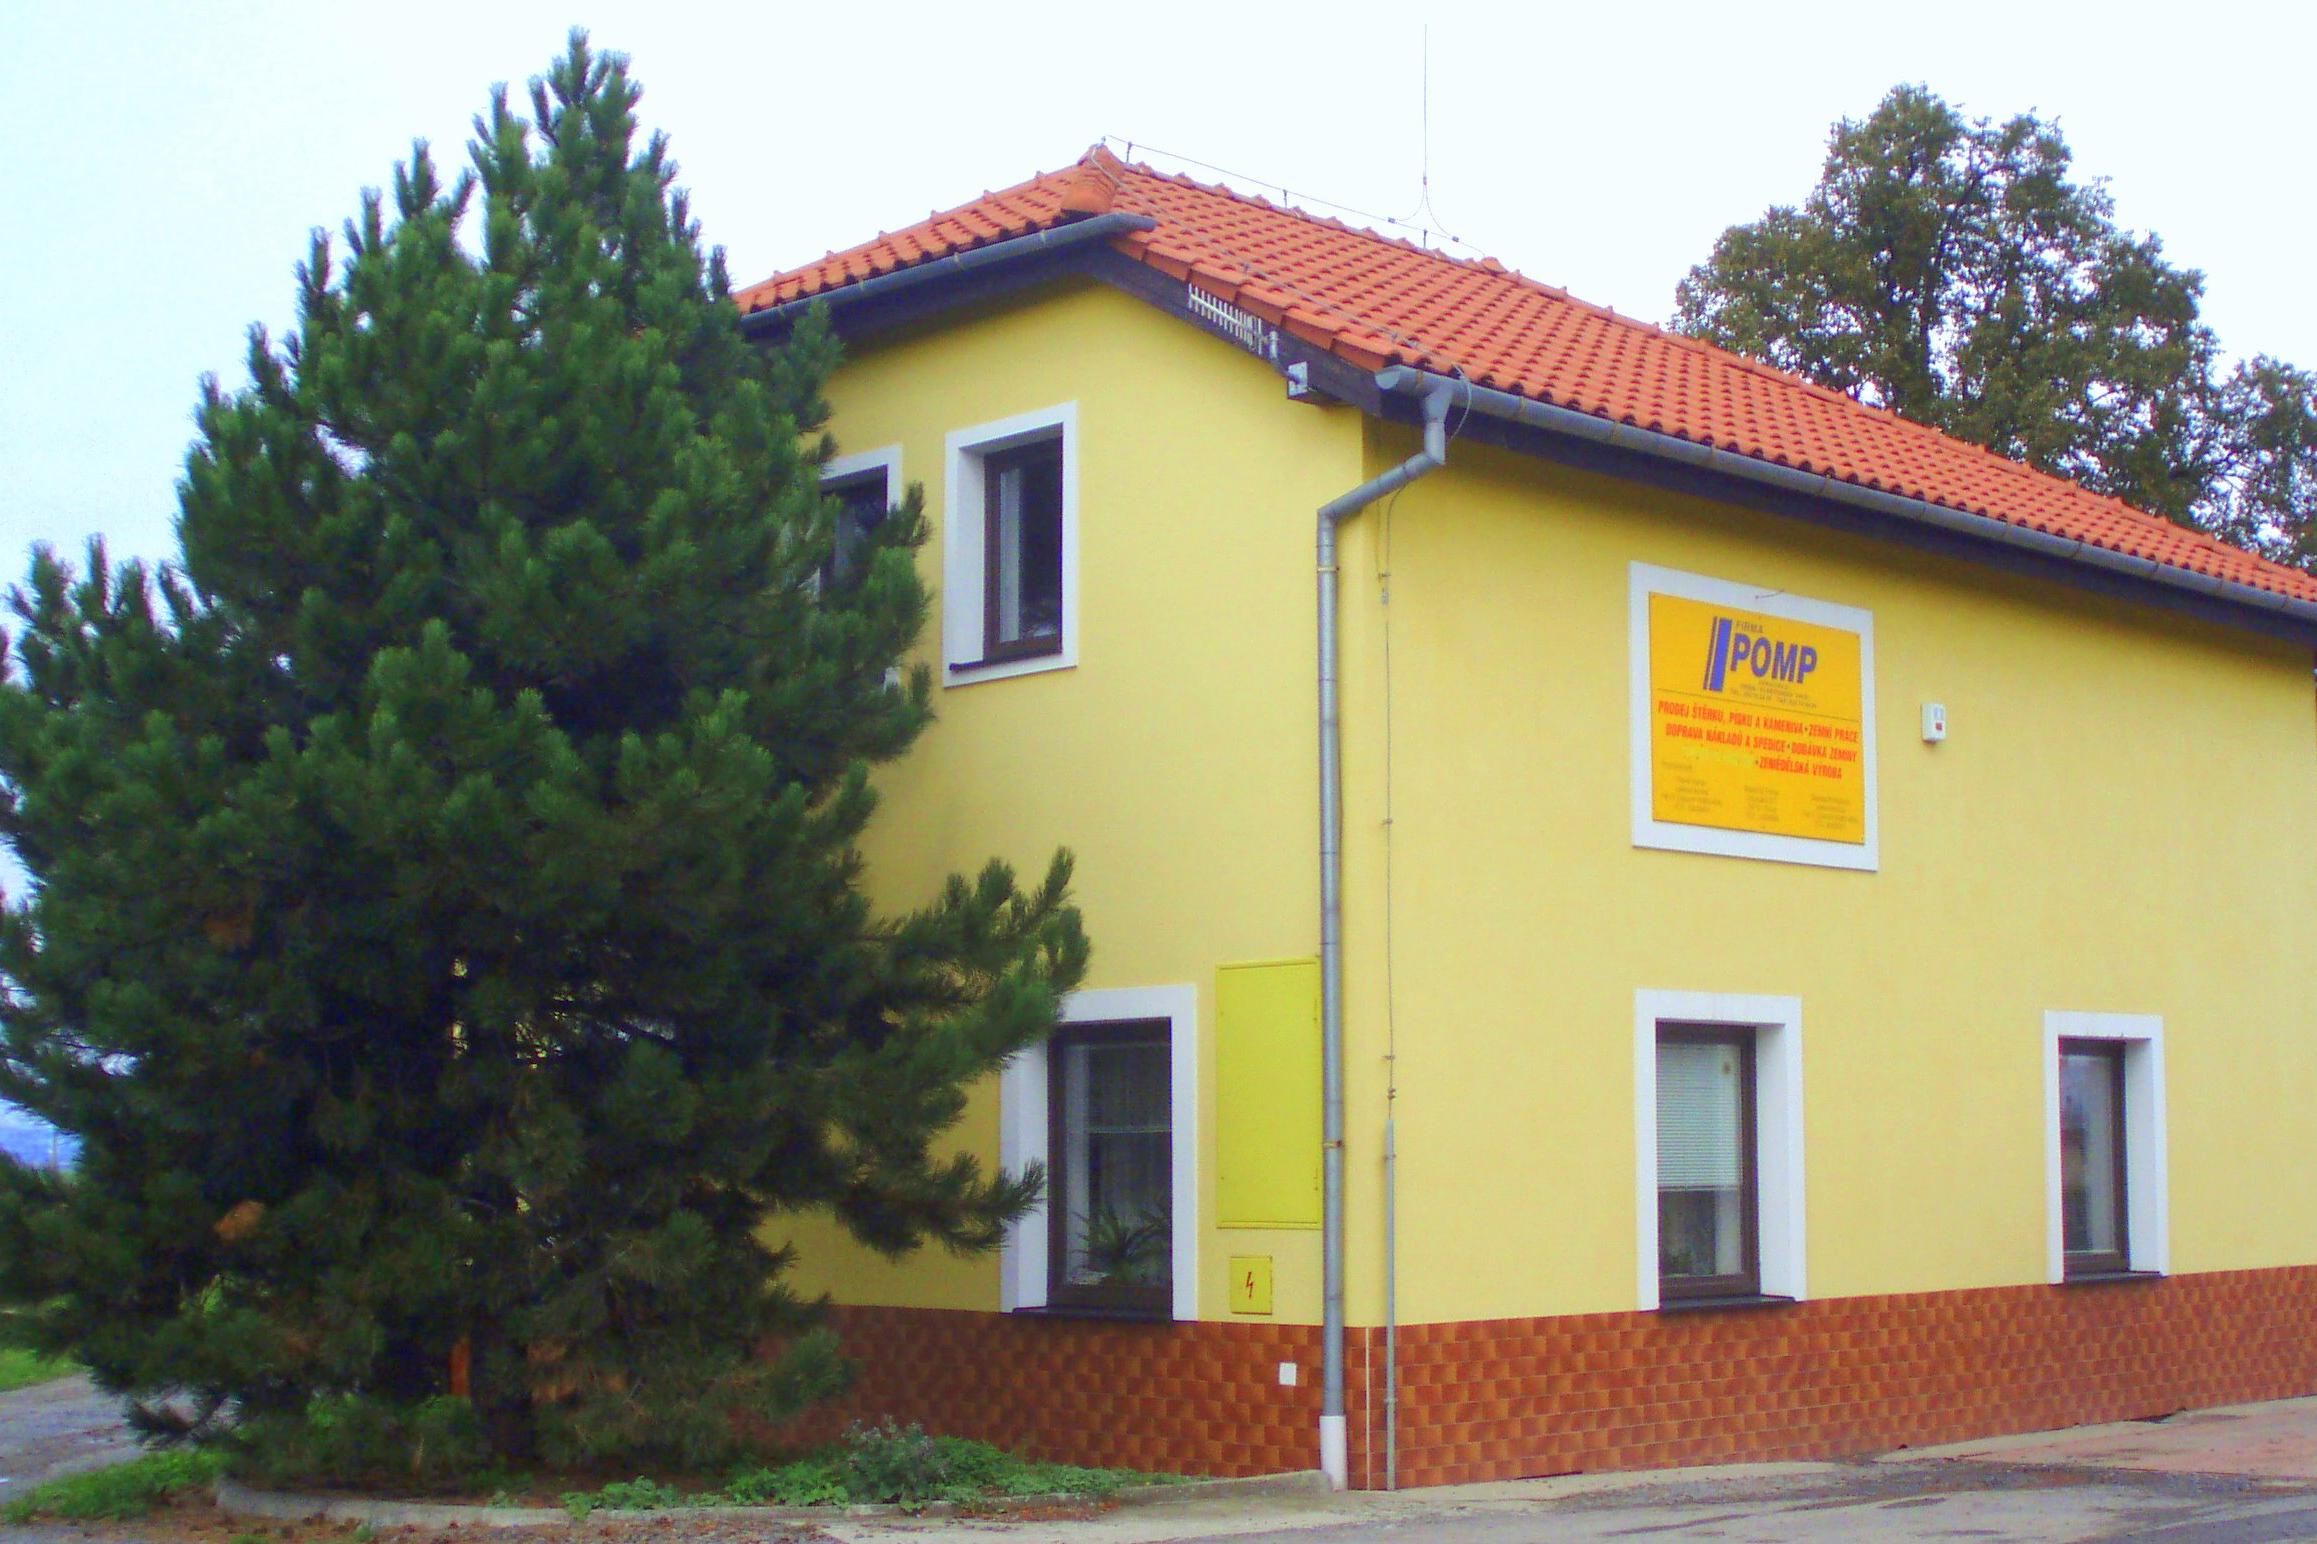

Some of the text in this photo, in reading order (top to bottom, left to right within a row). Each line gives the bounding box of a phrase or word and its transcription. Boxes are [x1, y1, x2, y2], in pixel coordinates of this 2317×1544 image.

[1735, 620, 1764, 634] FIRMA
[1658, 700, 1689, 718] PRODEJ
[1755, 715, 1761, 729] A
[1665, 723, 1703, 740] DOPRAVA
[1745, 735, 1751, 748] A
